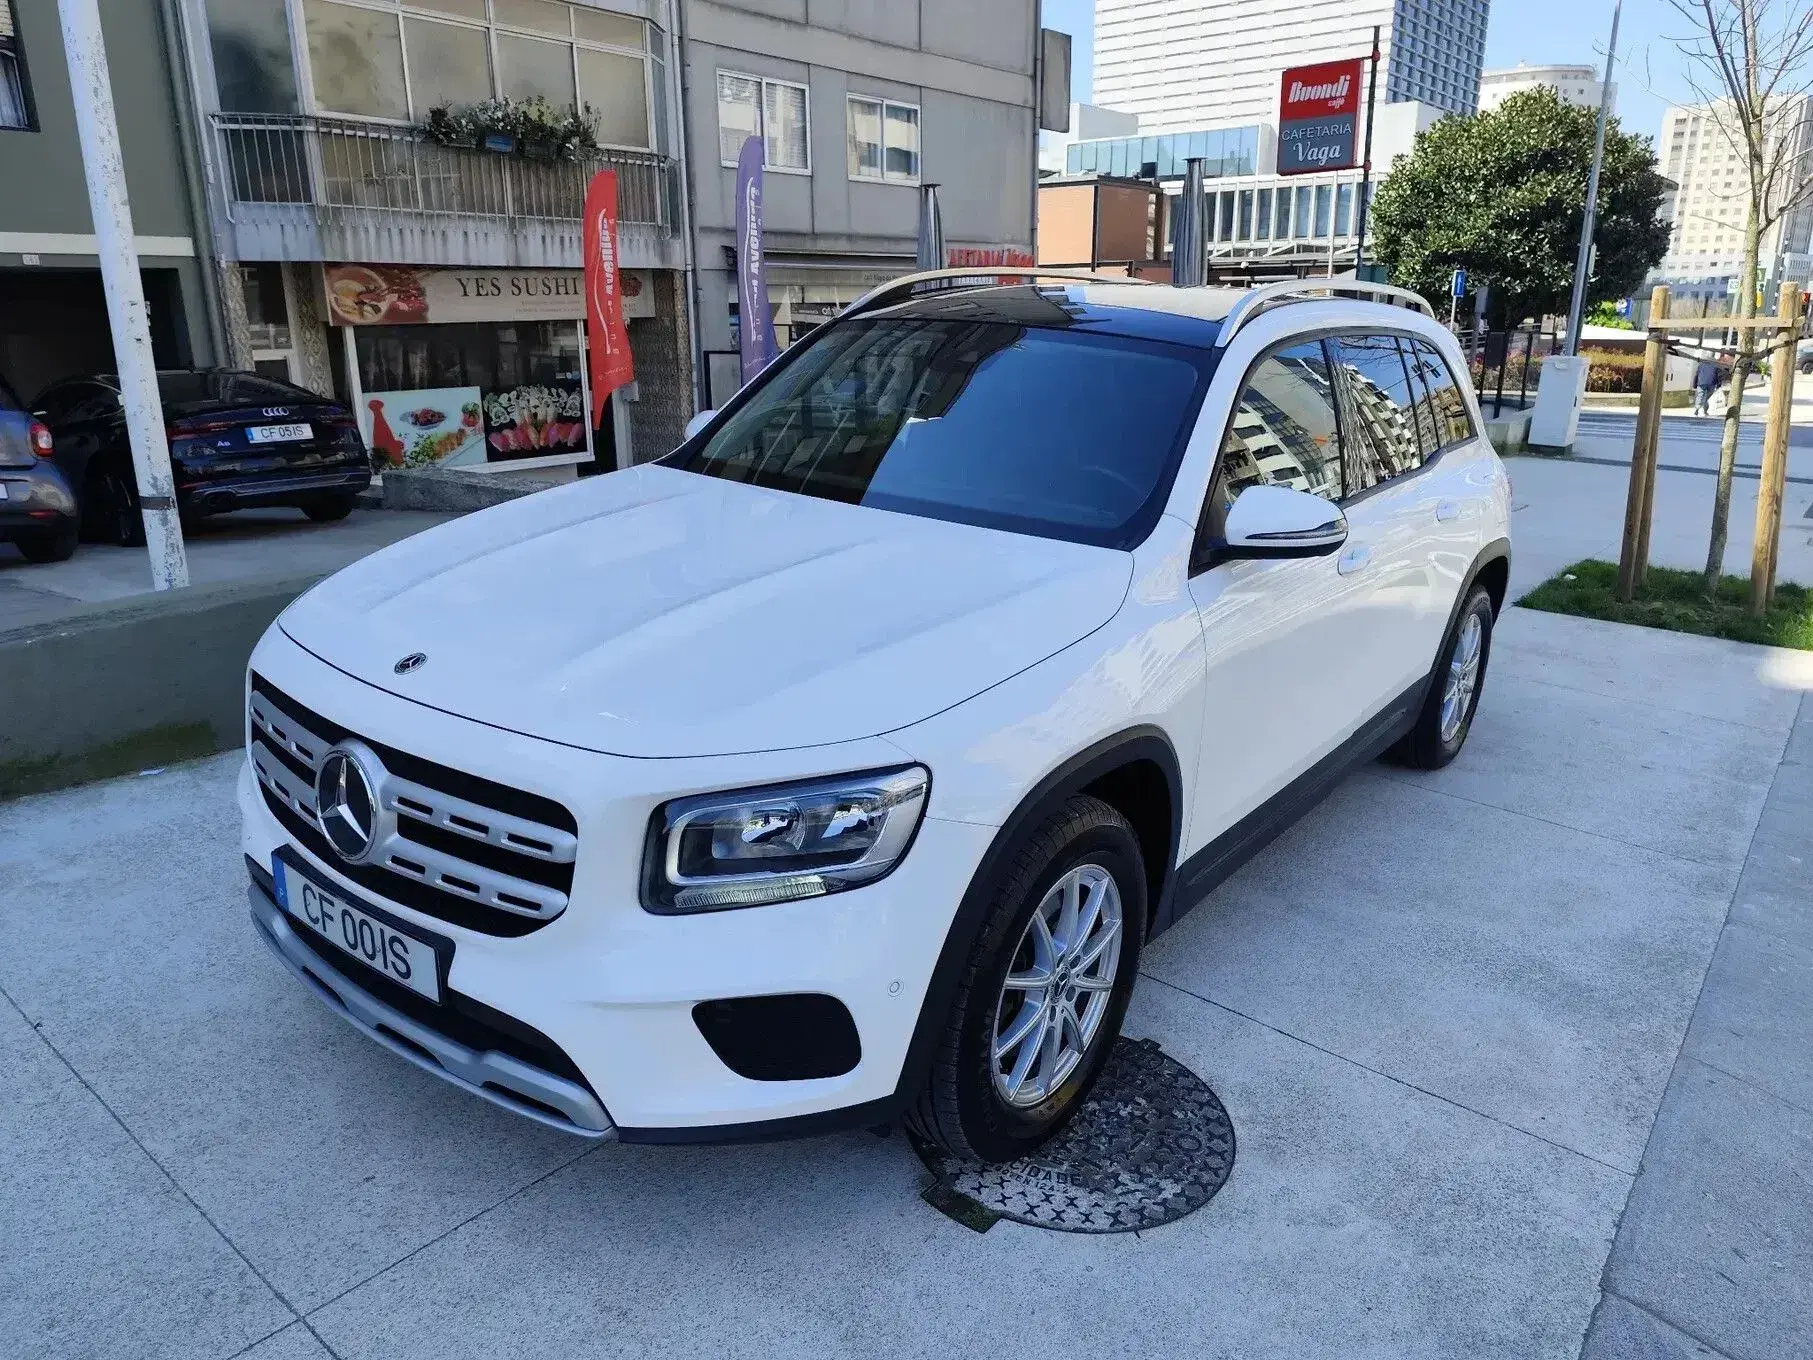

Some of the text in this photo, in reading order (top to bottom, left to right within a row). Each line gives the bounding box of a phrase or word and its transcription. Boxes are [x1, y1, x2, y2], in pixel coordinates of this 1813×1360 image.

[1288, 74, 1351, 104] Buondi
[1281, 123, 1352, 141] CAFETARIA
[1293, 141, 1342, 166] Vaga
[455, 276, 579, 297] YES SUSHI
[260, 427, 276, 439] CF
[302, 883, 335, 933] CF
